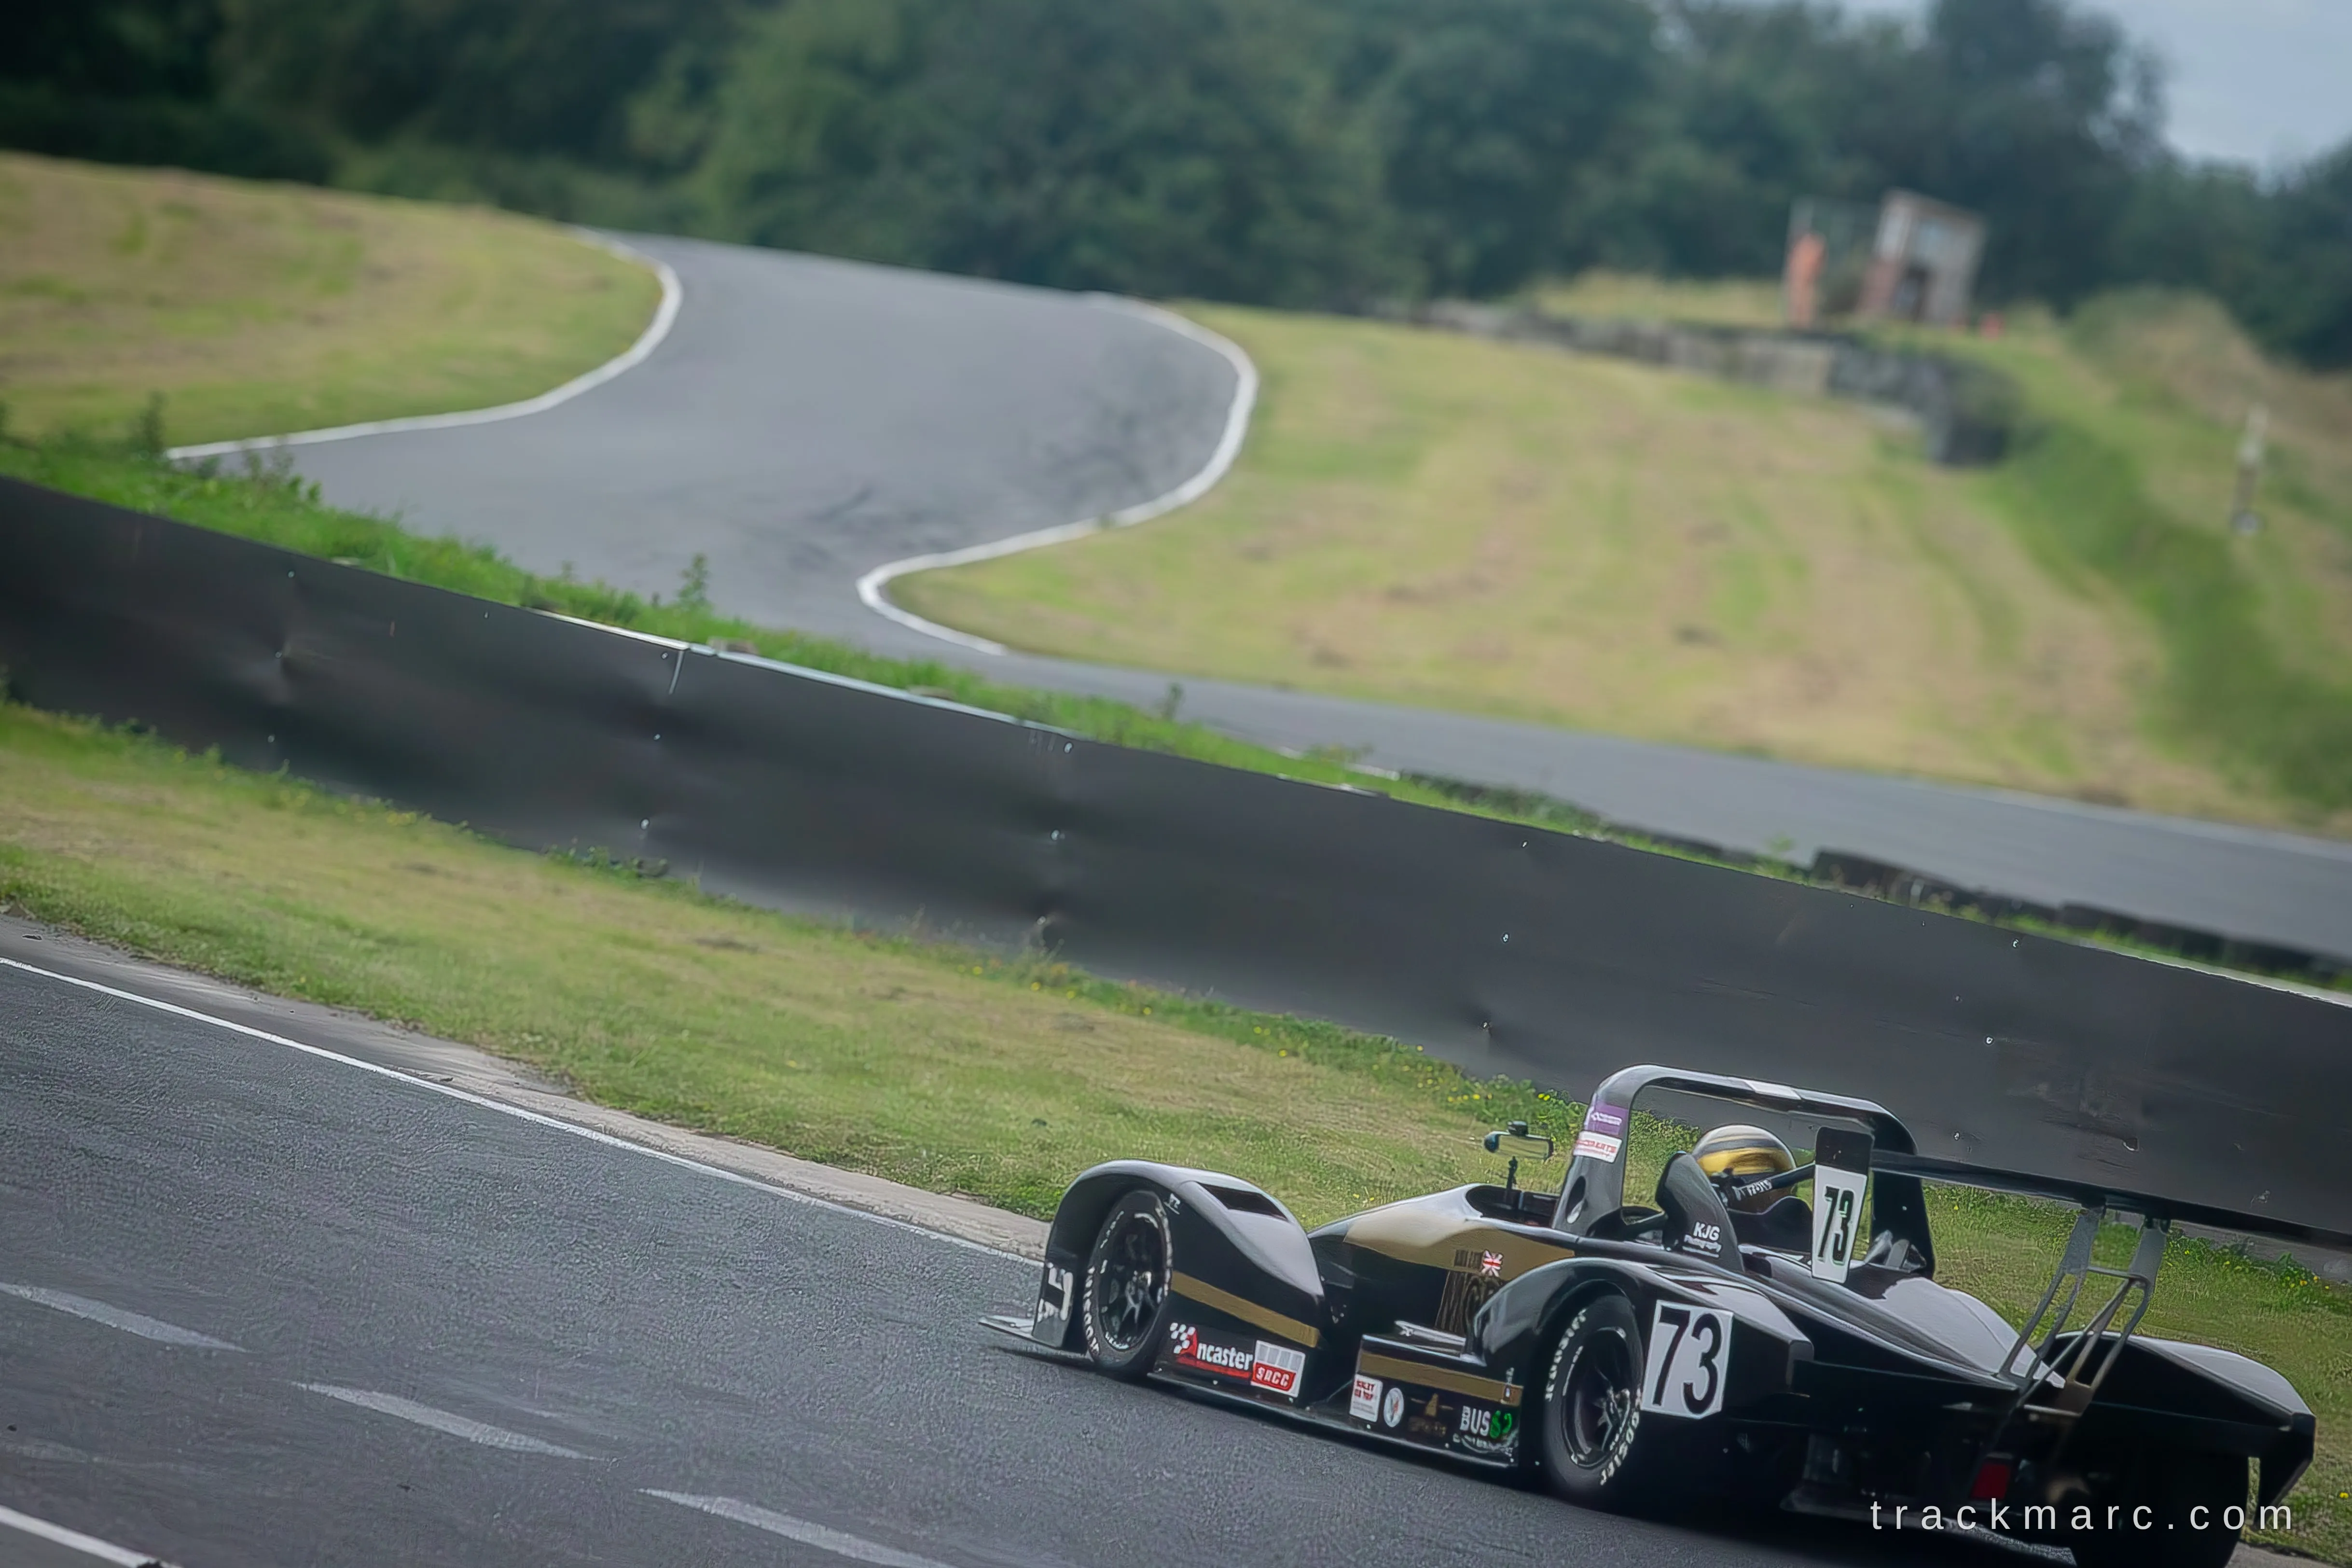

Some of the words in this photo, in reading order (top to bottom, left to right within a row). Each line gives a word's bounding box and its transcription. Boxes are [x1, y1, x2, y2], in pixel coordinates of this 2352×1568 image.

[1693, 1221, 1720, 1241] KJG
[1817, 1186, 1854, 1264] 73
[1652, 1304, 1722, 1414] 73
